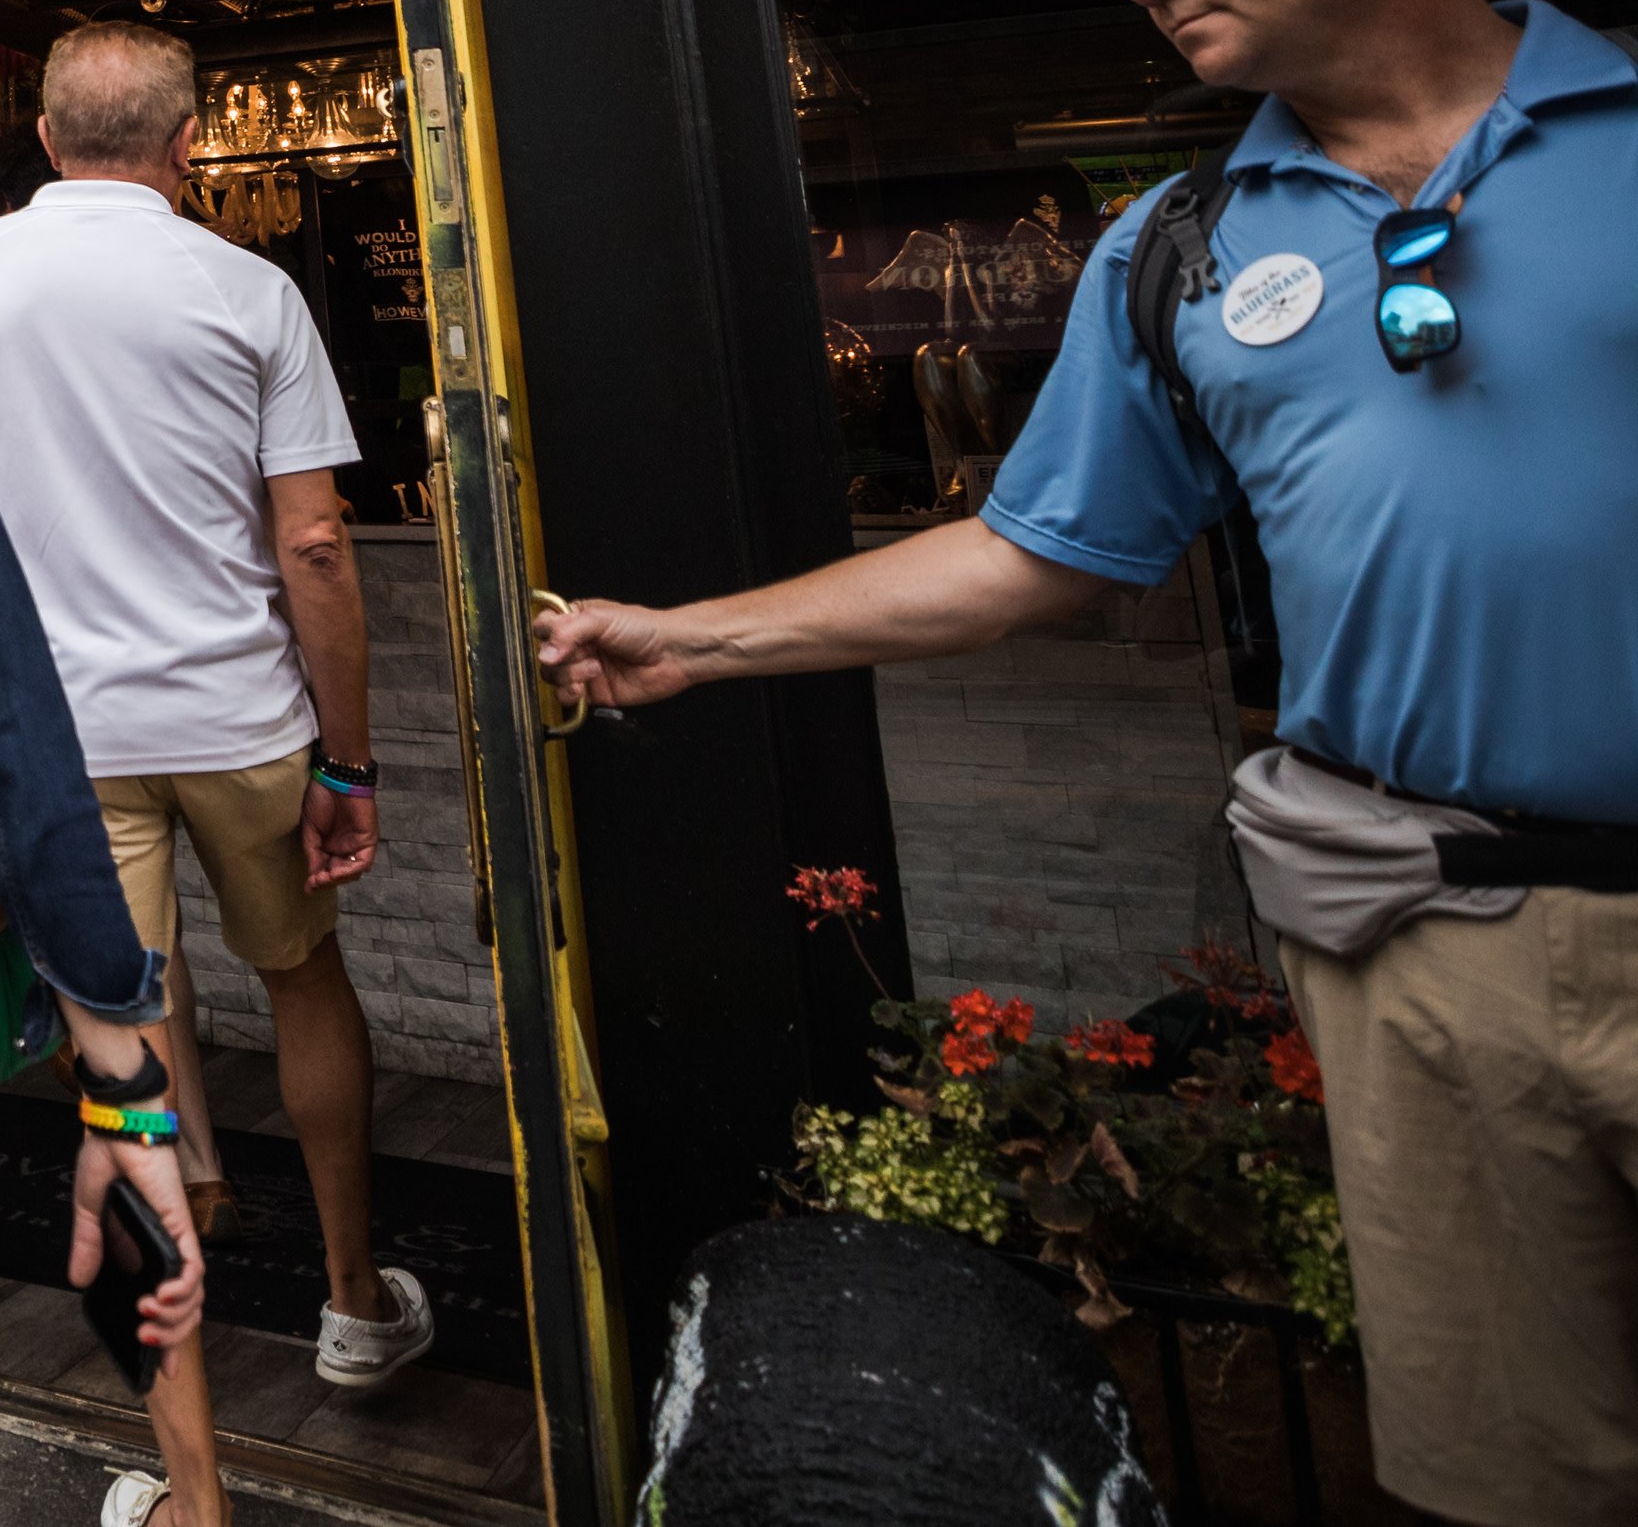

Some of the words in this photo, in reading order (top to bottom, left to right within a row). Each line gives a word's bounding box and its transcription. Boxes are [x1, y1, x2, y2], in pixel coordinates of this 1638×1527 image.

[398, 219, 406, 230] I
[354, 232, 417, 245] WOULD
[371, 244, 388, 253] DO
[1230, 265, 1311, 324] BLUEGRASS
